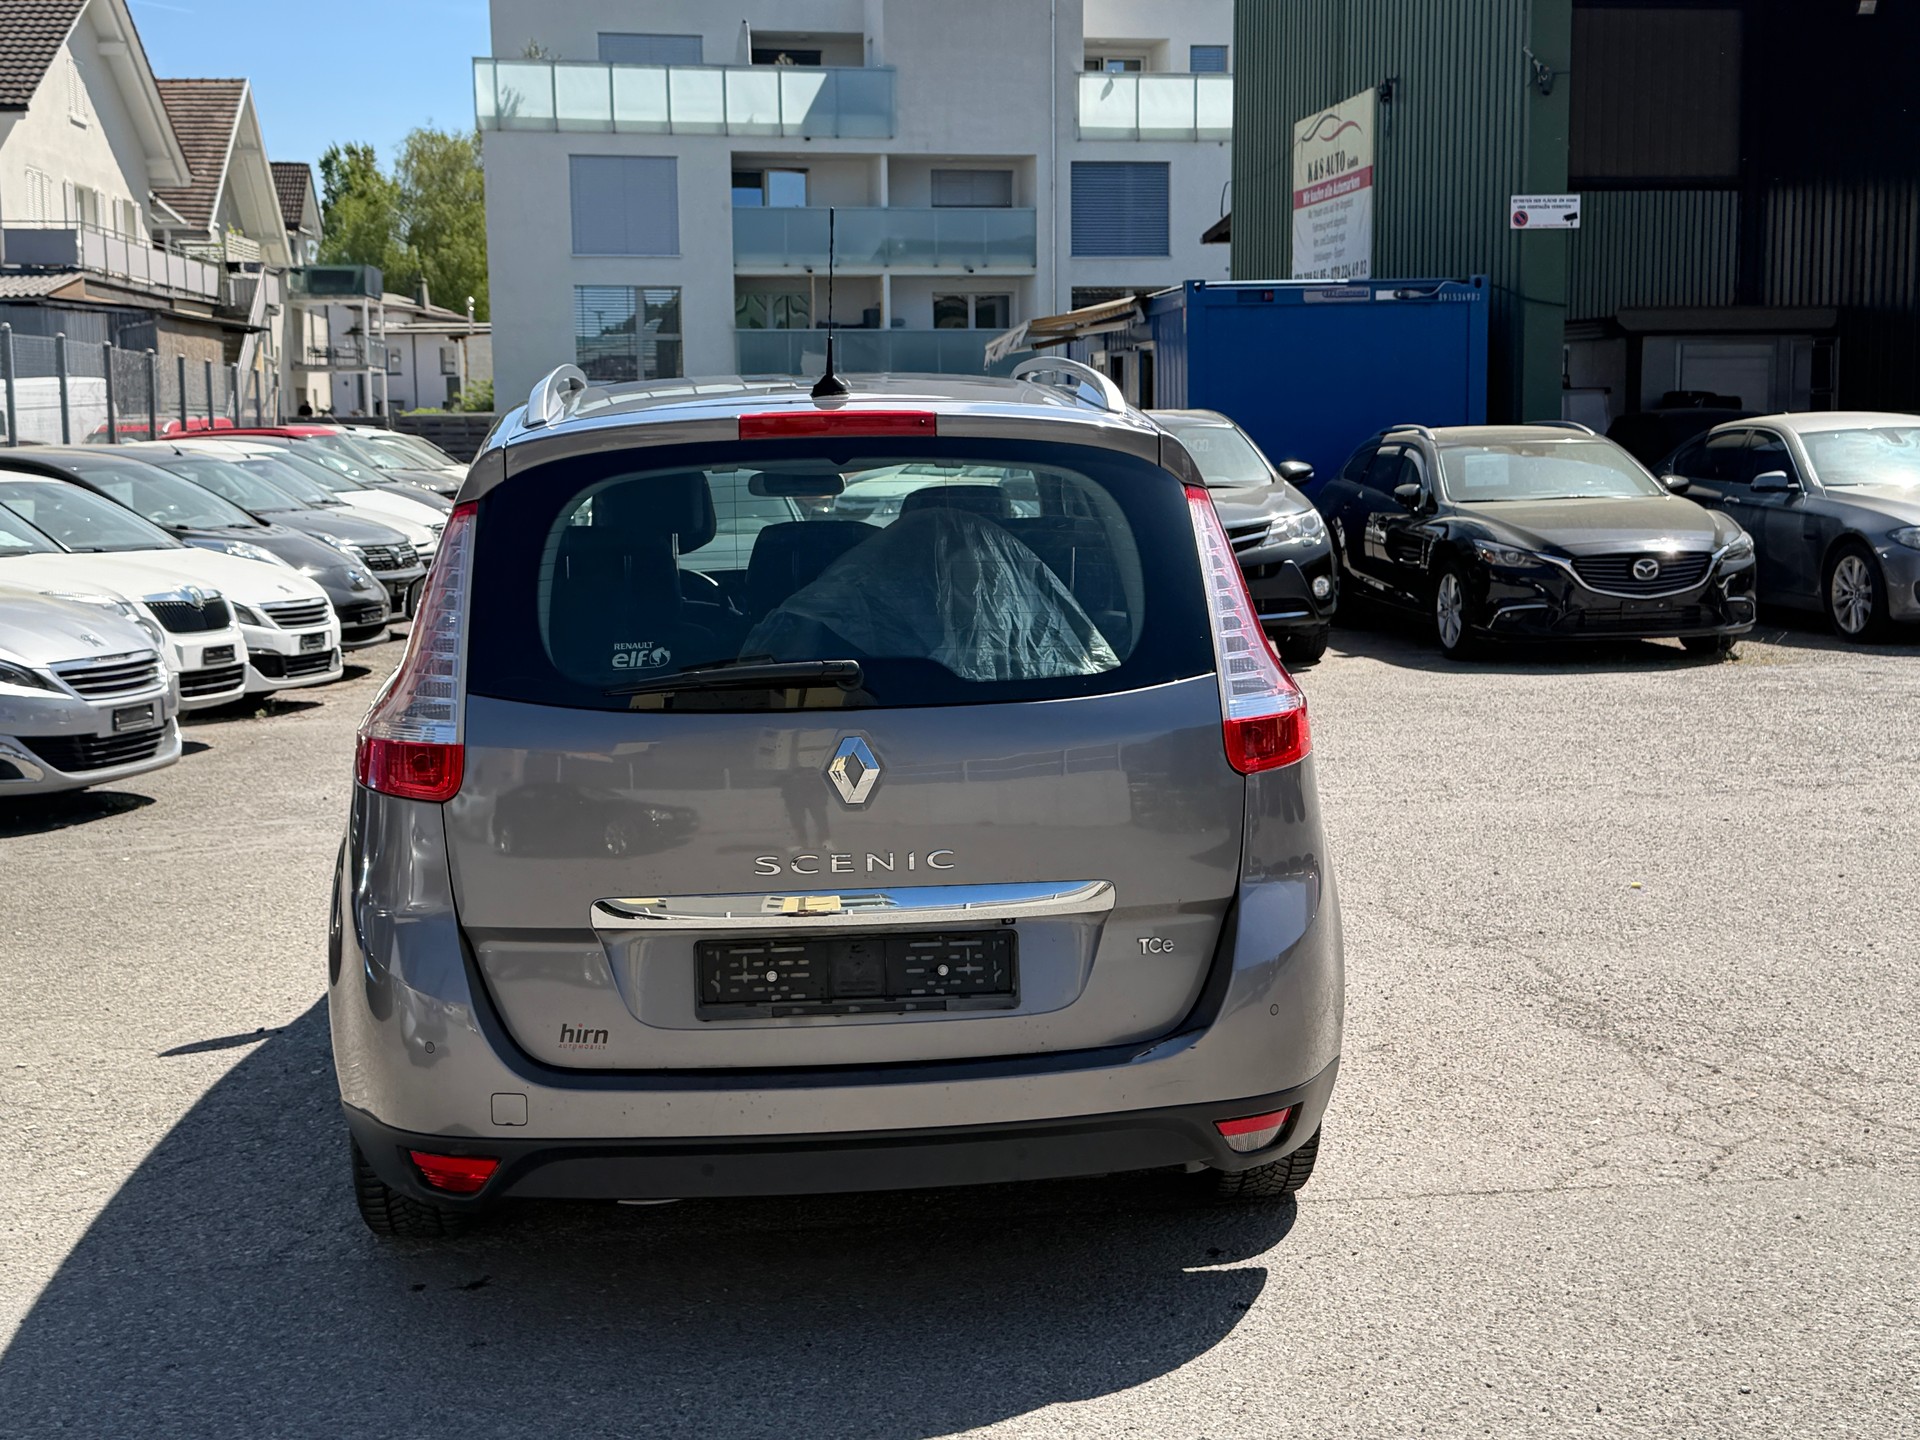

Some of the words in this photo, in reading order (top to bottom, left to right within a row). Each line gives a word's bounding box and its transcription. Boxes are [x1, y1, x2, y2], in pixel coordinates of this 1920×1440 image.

[1326, 150, 1346, 176] AUTO
[614, 642, 654, 650] RENAULT
[612, 650, 649, 668] elf
[754, 849, 955, 876] SCENIC
[1138, 936, 1174, 955] TCe
[560, 1023, 609, 1044] hirn
